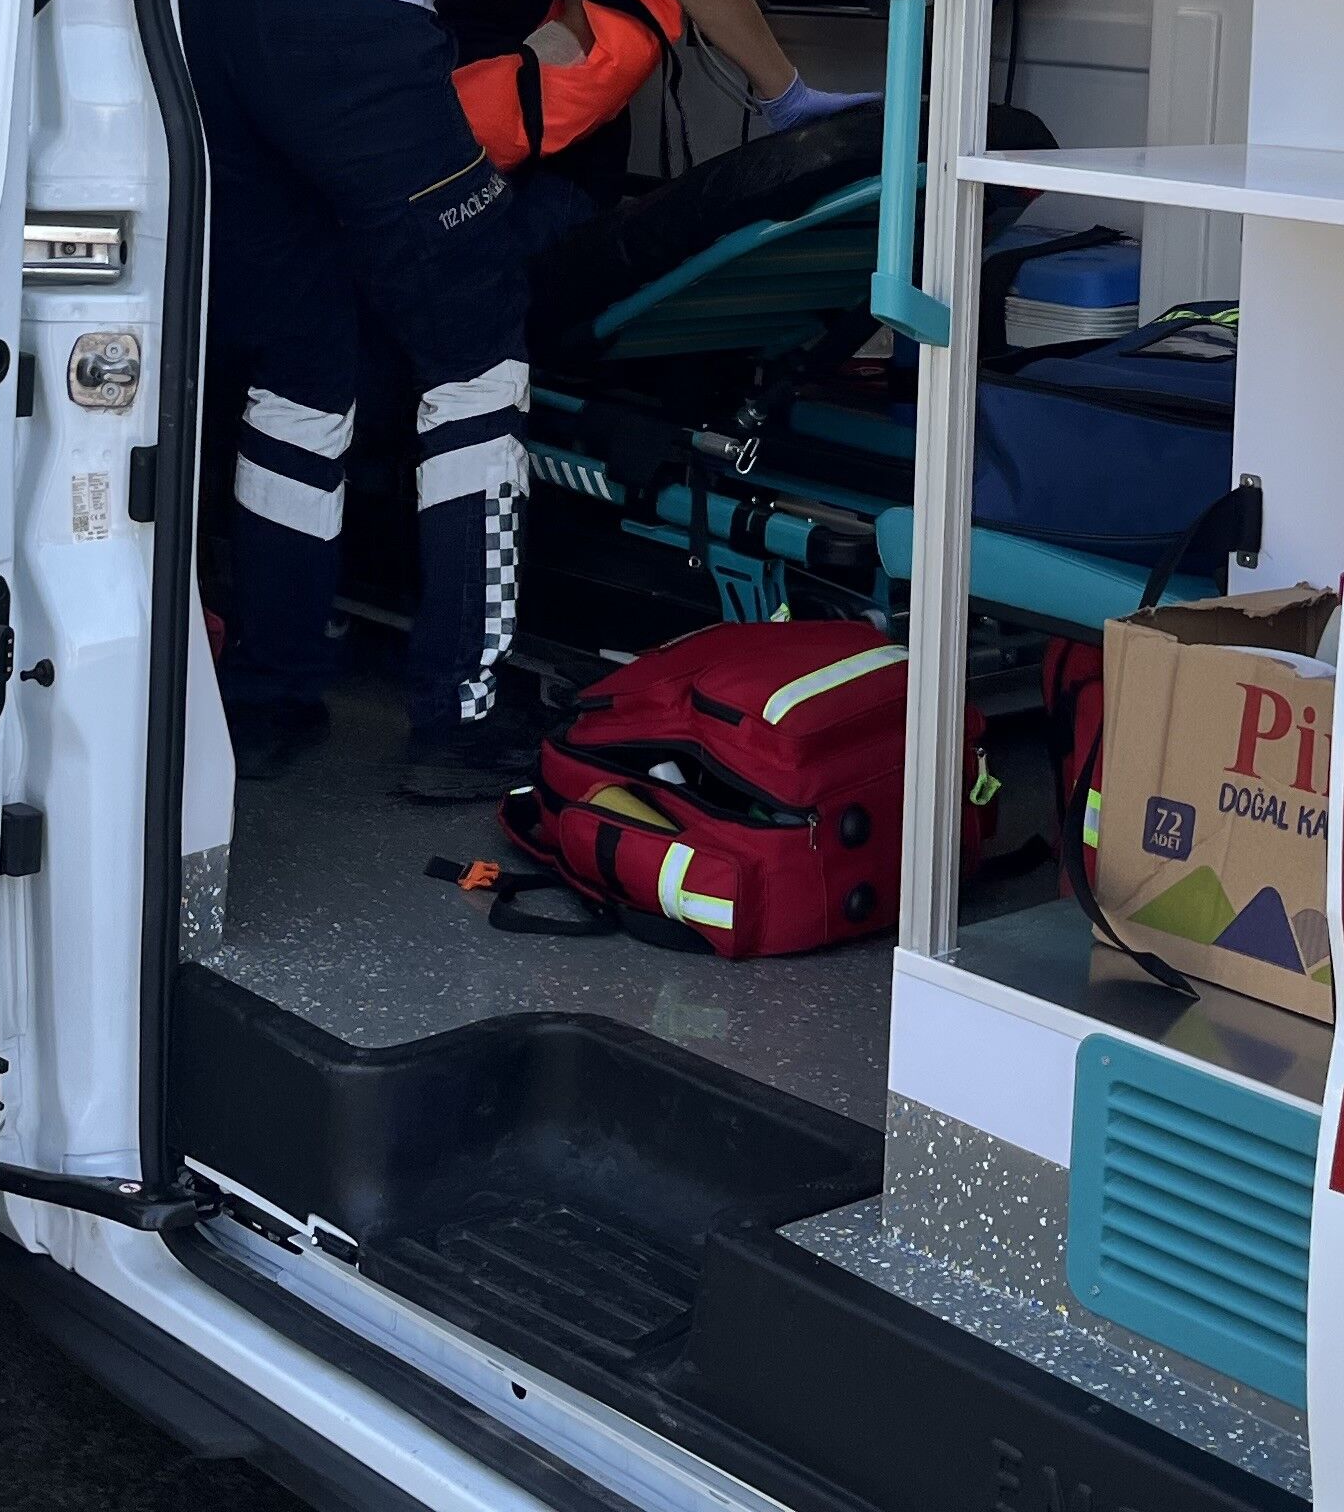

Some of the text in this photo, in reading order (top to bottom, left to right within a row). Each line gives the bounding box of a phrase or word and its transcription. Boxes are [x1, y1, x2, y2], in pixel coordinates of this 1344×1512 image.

[1223, 682, 1333, 798] Pi
[1156, 808, 1183, 836] 72
[1218, 782, 1289, 831] DOĞAL
[1149, 833, 1182, 851] ADET
